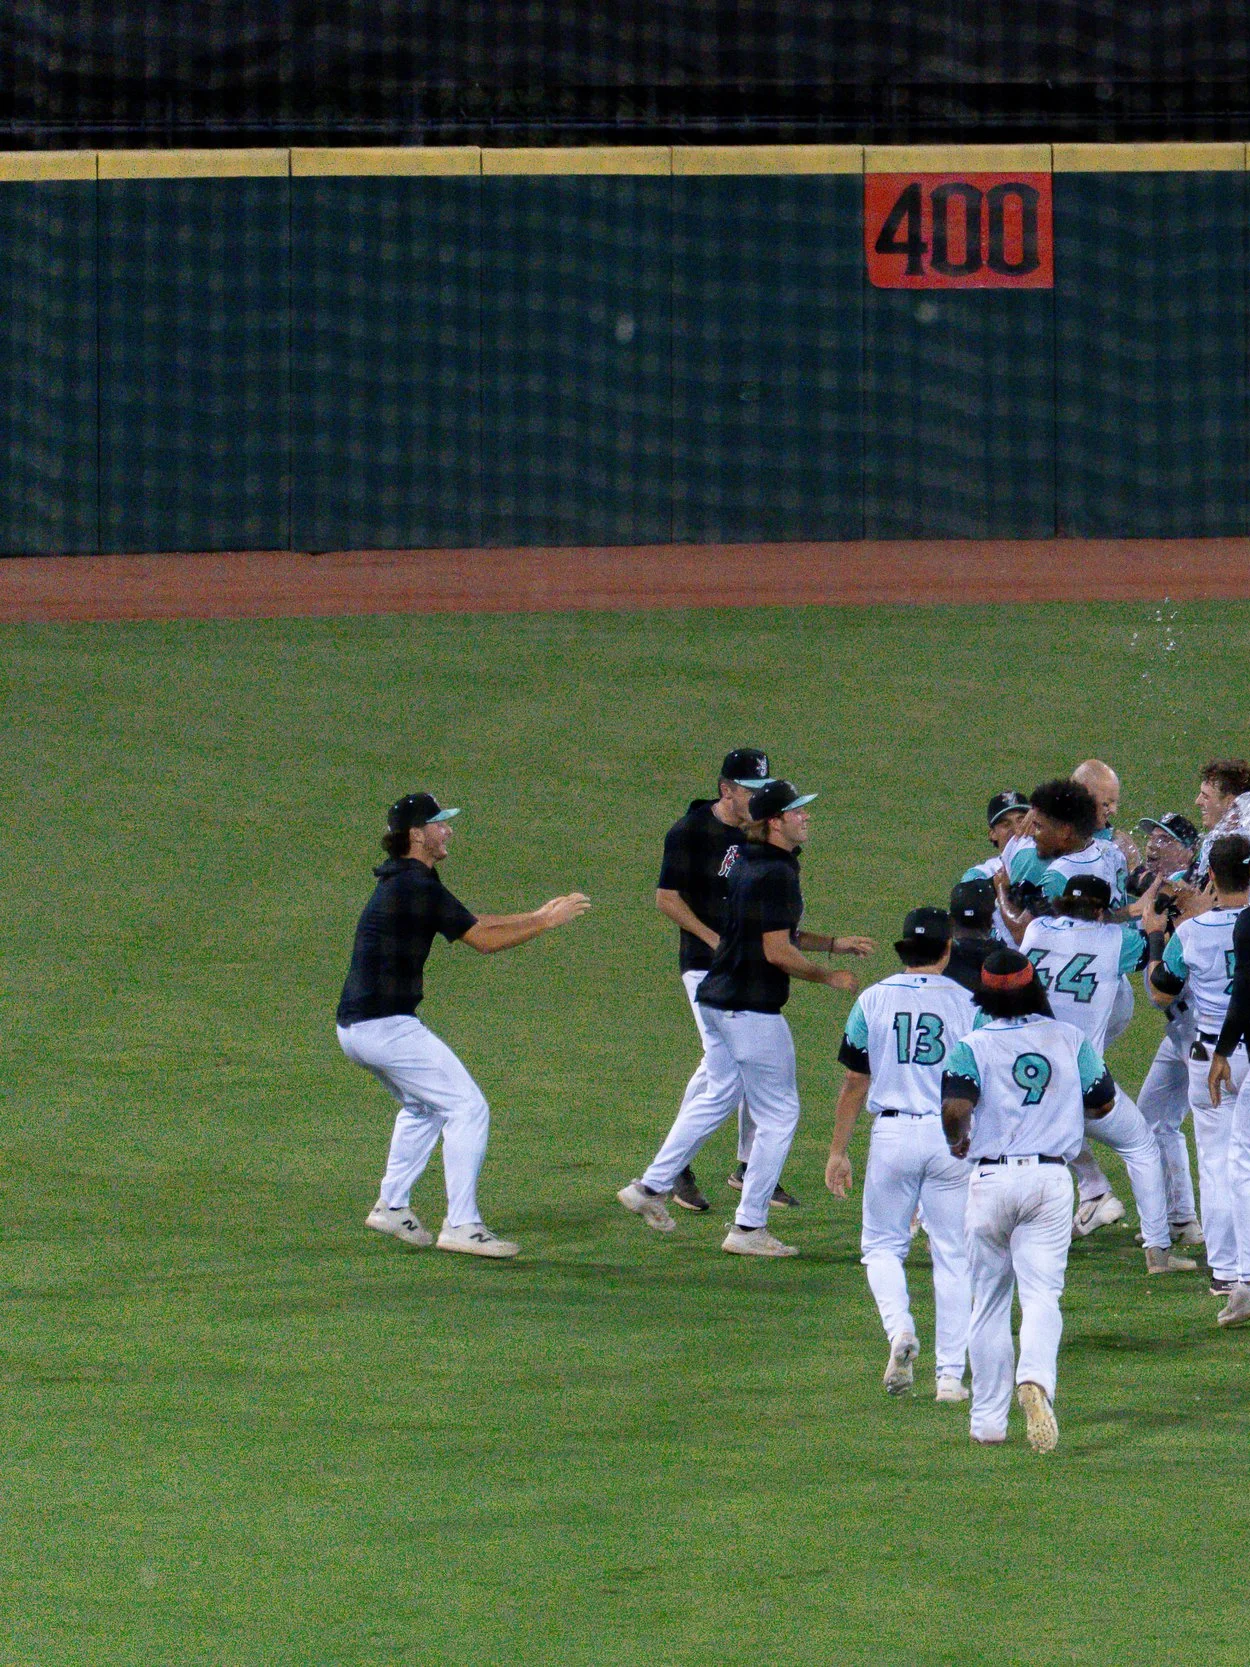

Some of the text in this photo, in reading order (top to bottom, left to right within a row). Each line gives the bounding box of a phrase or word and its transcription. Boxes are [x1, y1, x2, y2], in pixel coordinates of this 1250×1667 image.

[875, 182, 1041, 276] 400
[893, 1012, 946, 1066] 13
[1012, 1053, 1052, 1107] 9
